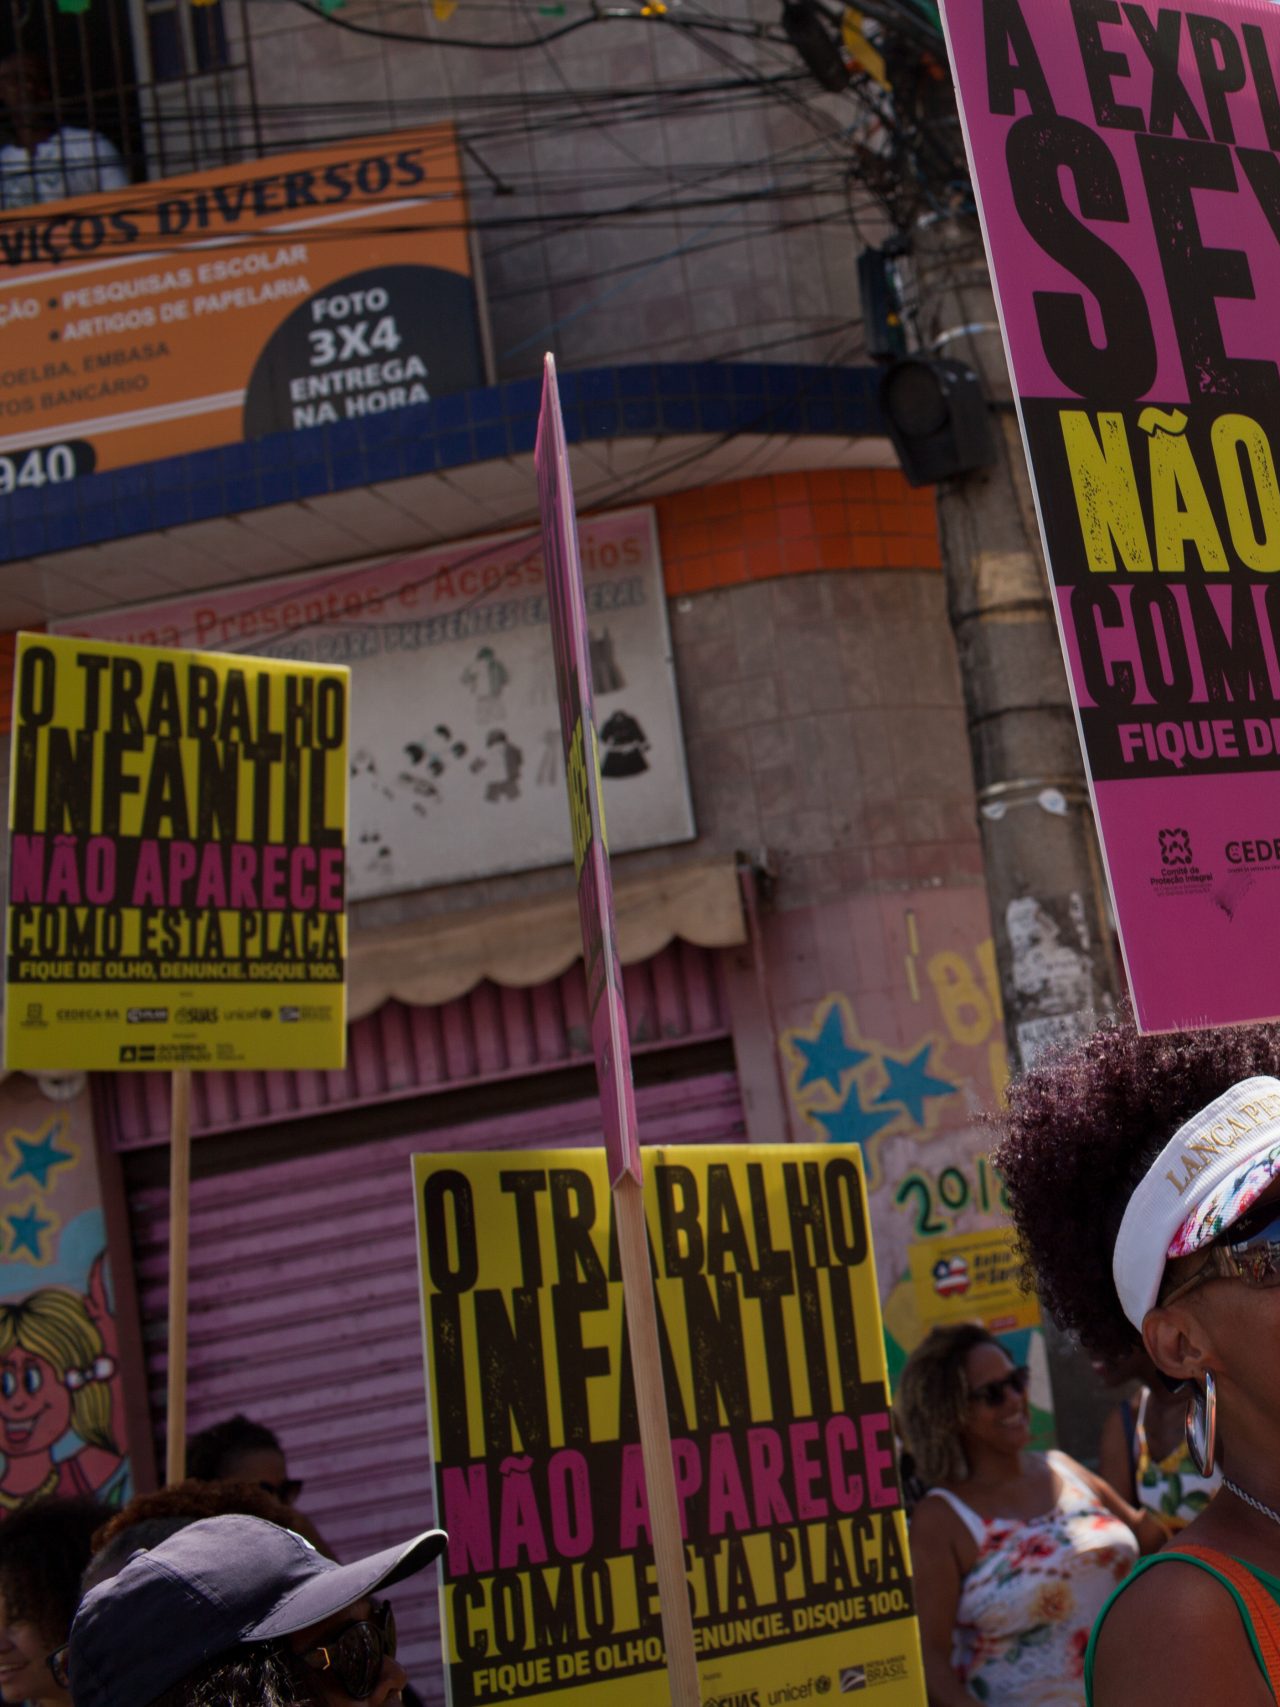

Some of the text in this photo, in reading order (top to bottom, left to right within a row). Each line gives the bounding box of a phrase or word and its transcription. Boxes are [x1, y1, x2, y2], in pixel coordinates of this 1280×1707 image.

[984, 0, 1057, 117] A
[157, 148, 426, 236] DIVERSOS
[62, 268, 192, 310] PESQUISAS
[198, 245, 308, 284] ESCOLAR
[63, 277, 310, 340] ARTIGOS DE PAPELARIA
[312, 288, 389, 322] FOTO
[84, 342, 169, 372] EMBASA
[309, 316, 400, 367] 3X4
[290, 356, 427, 402] ENTREGA
[292, 383, 429, 430] NA HORA
[193, 584, 385, 645] Presentes
[433, 535, 642, 599] Acessios
[18, 646, 344, 750] O TRABALHO
[1118, 720, 1240, 769] FIQUE
[13, 725, 344, 845] INFANTIL
[10, 834, 345, 911] NÃO APARECE
[11, 905, 343, 960] COMO ESTA PLACA
[19, 961, 339, 981] FIQUE DE OLHO, DENUNCIE. DISQUE 100.
[1166, 1110, 1249, 1195] LANÇA
[423, 1169, 479, 1293] O
[442, 1448, 594, 1577] NÃO
[454, 1558, 615, 1661] COMO
[771, 1511, 908, 1598] PLACA
[473, 1590, 909, 1696] FIQUE DE OLHO, ENUNCIE. DISQUE 100.
[767, 1676, 813, 1706] unicef
